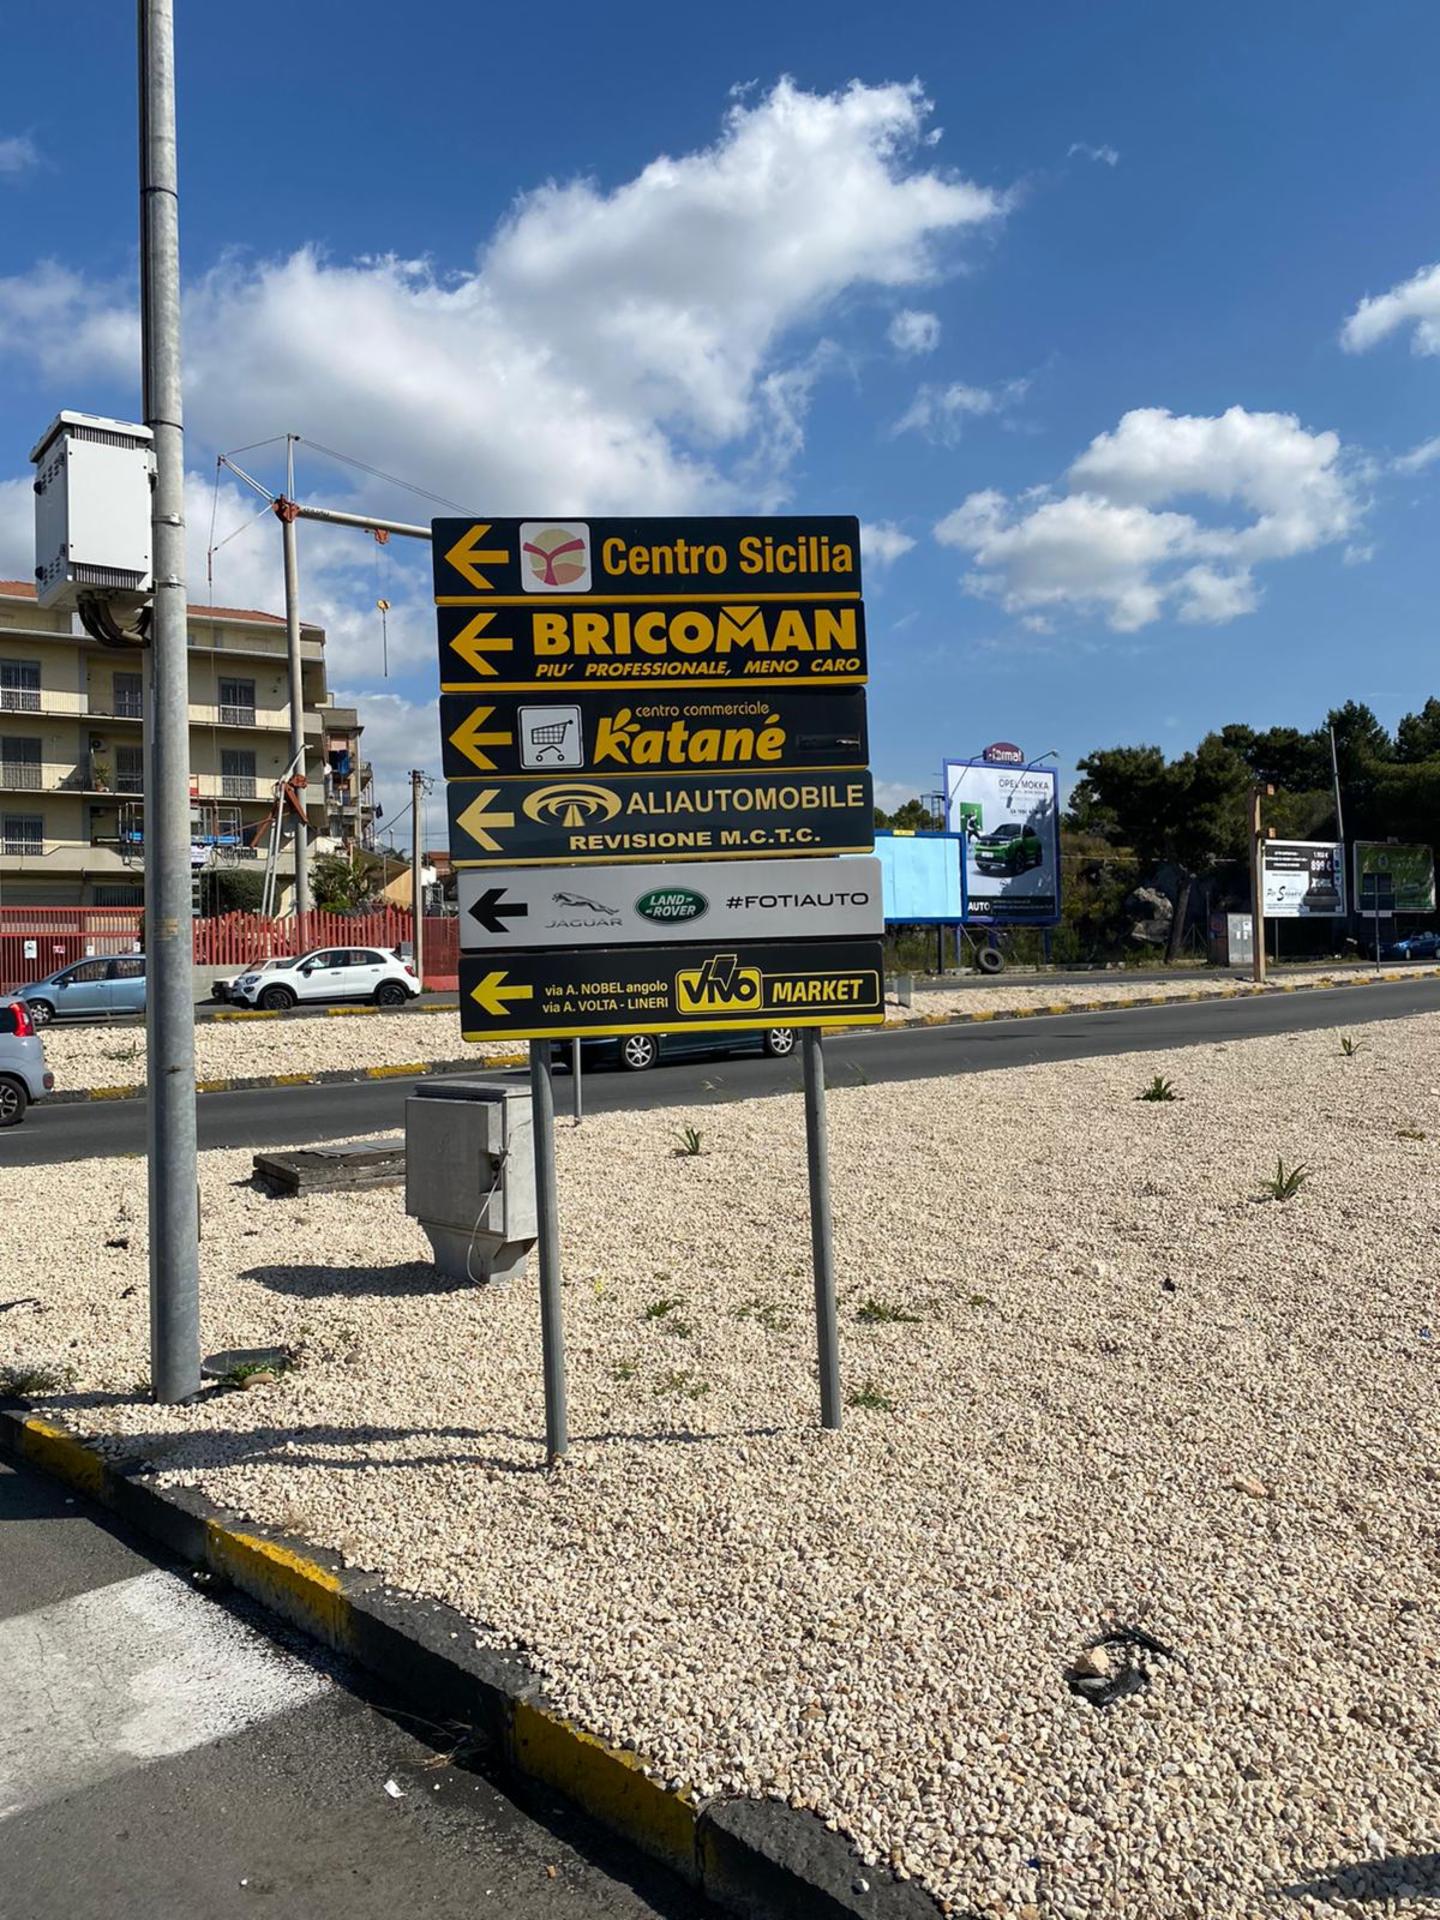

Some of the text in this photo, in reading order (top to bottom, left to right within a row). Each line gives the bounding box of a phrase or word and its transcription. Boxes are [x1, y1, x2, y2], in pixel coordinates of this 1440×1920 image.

[602, 536, 853, 576] Centro Sicilia
[533, 606, 857, 656] BRICOMAN
[535, 657, 861, 678] PIU' PROFESSIONALE, MENO CARO
[635, 700, 771, 718] centro commerciale
[1021, 780, 1049, 789] MOKKA
[626, 784, 865, 815] ALIAUTOMOBILE
[569, 827, 822, 850] REVISIONE M.C.T.C.
[649, 895, 686, 908] LAND
[725, 892, 869, 909] #FOTIAUTO
[652, 904, 697, 917] ROVER
[545, 918, 623, 929] JAGUAR
[544, 980, 668, 997] via A. NOBEL angolo
[772, 979, 864, 1002] MARKET
[542, 1001, 562, 1013] via
[564, 1001, 577, 1013] A.
[578, 999, 618, 1012] VOLTA
[627, 996, 669, 1010] LINERI
